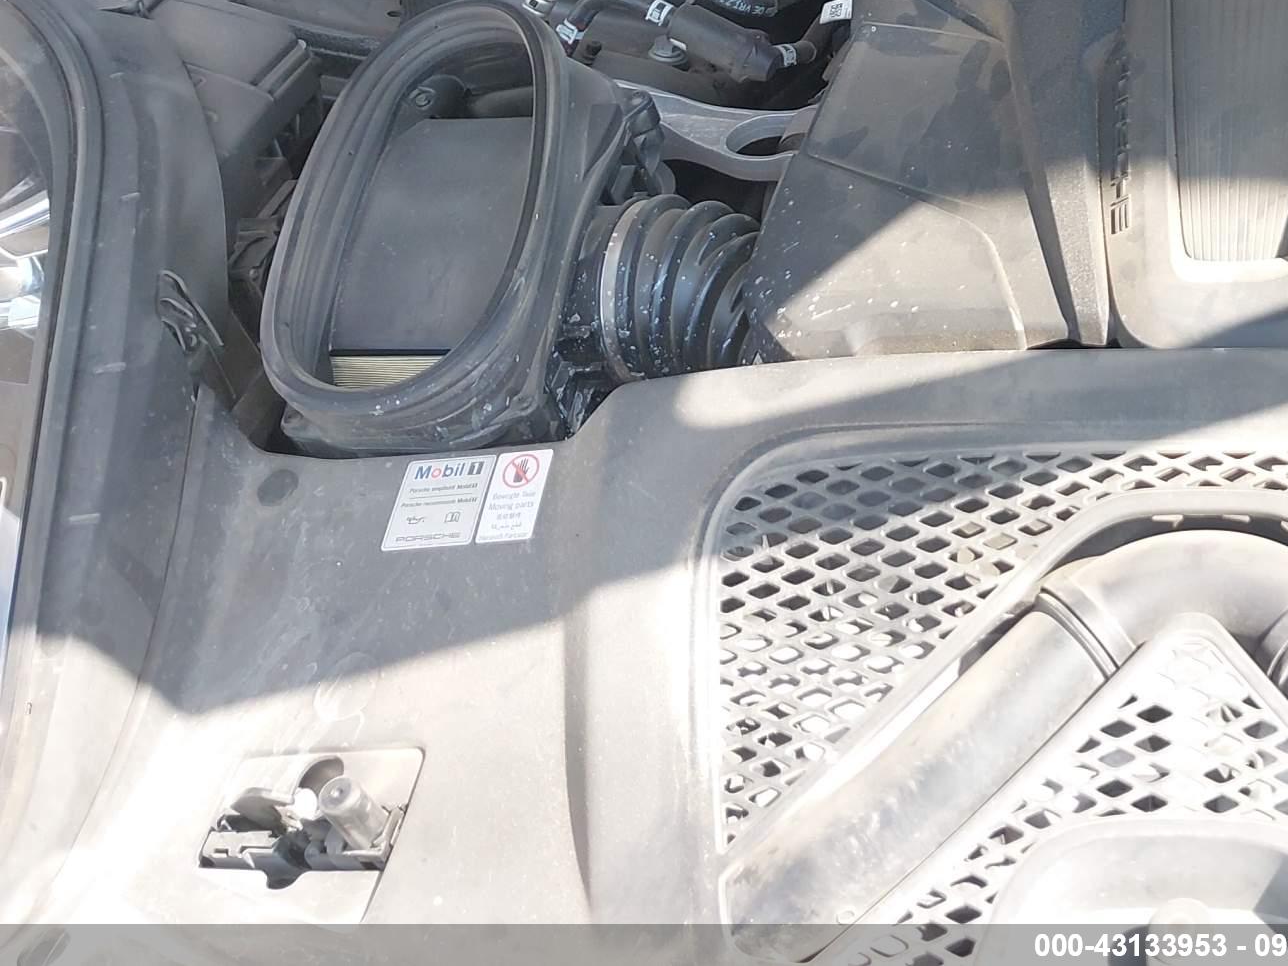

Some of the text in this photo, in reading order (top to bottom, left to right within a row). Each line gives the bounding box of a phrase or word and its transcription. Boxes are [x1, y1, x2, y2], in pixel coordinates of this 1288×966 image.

[414, 461, 482, 480] Mobil 1
[395, 532, 461, 542] PORSCHE
